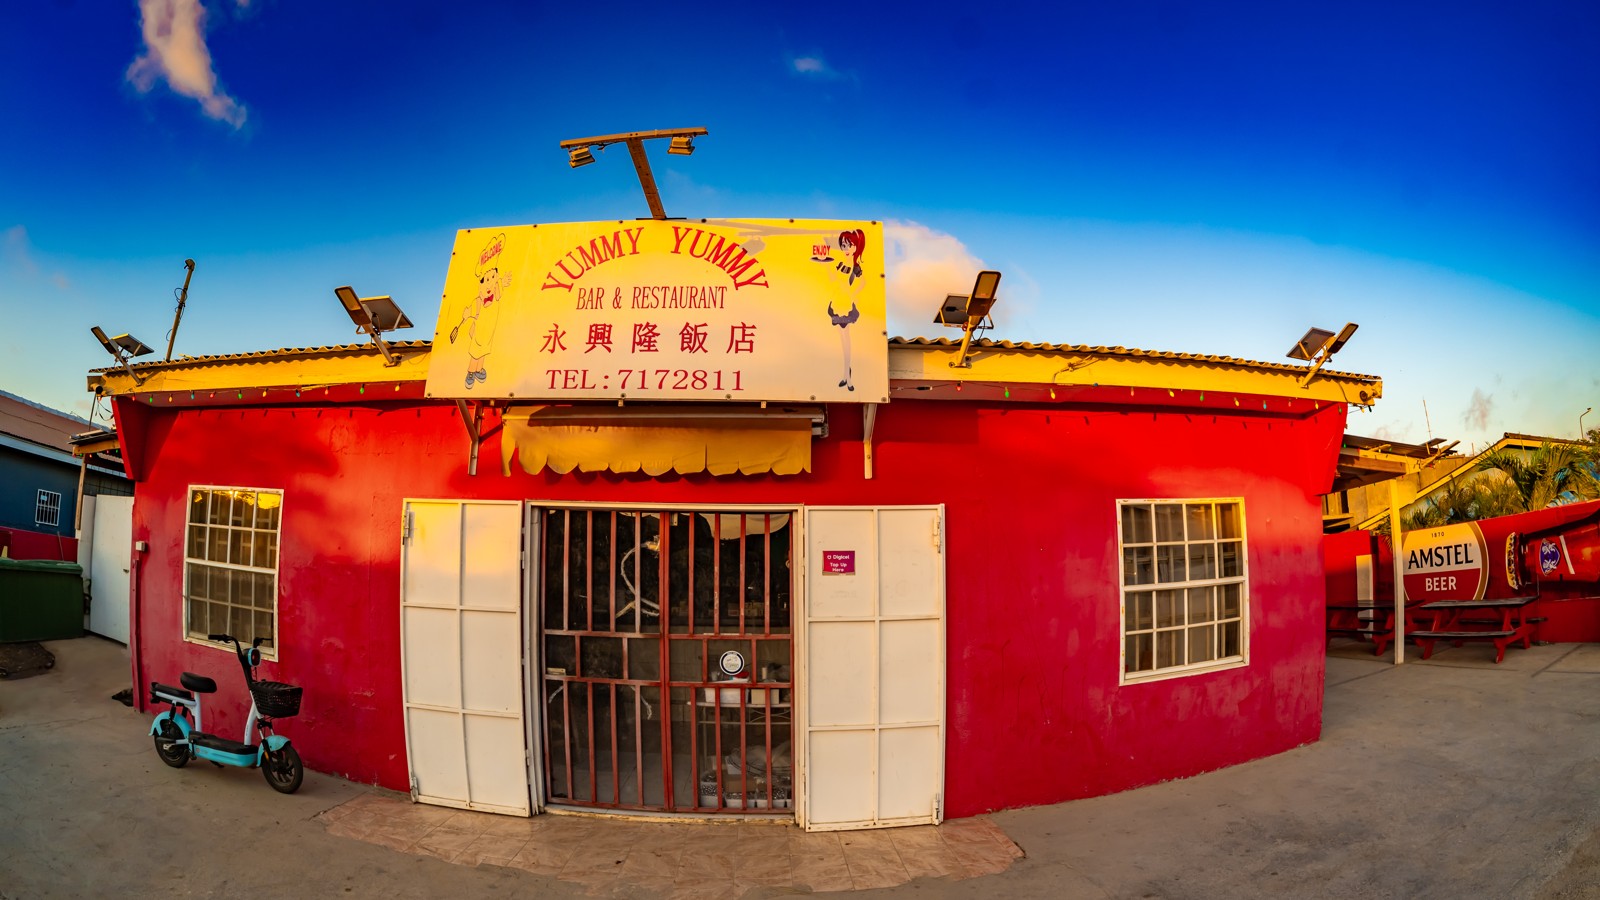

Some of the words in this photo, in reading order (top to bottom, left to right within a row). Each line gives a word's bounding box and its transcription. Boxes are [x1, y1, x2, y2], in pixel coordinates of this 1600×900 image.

[541, 227, 644, 292] YUMMY
[671, 226, 769, 290] YUMMY
[813, 245, 830, 255] ENJOY
[576, 287, 605, 310] BAR
[613, 287, 622, 309] &
[631, 286, 728, 309] RESTAURANT
[539, 321, 757, 354] 永興隆飯店
[1408, 543, 1473, 569] AMSTEL
[1425, 576, 1457, 591] BEER
